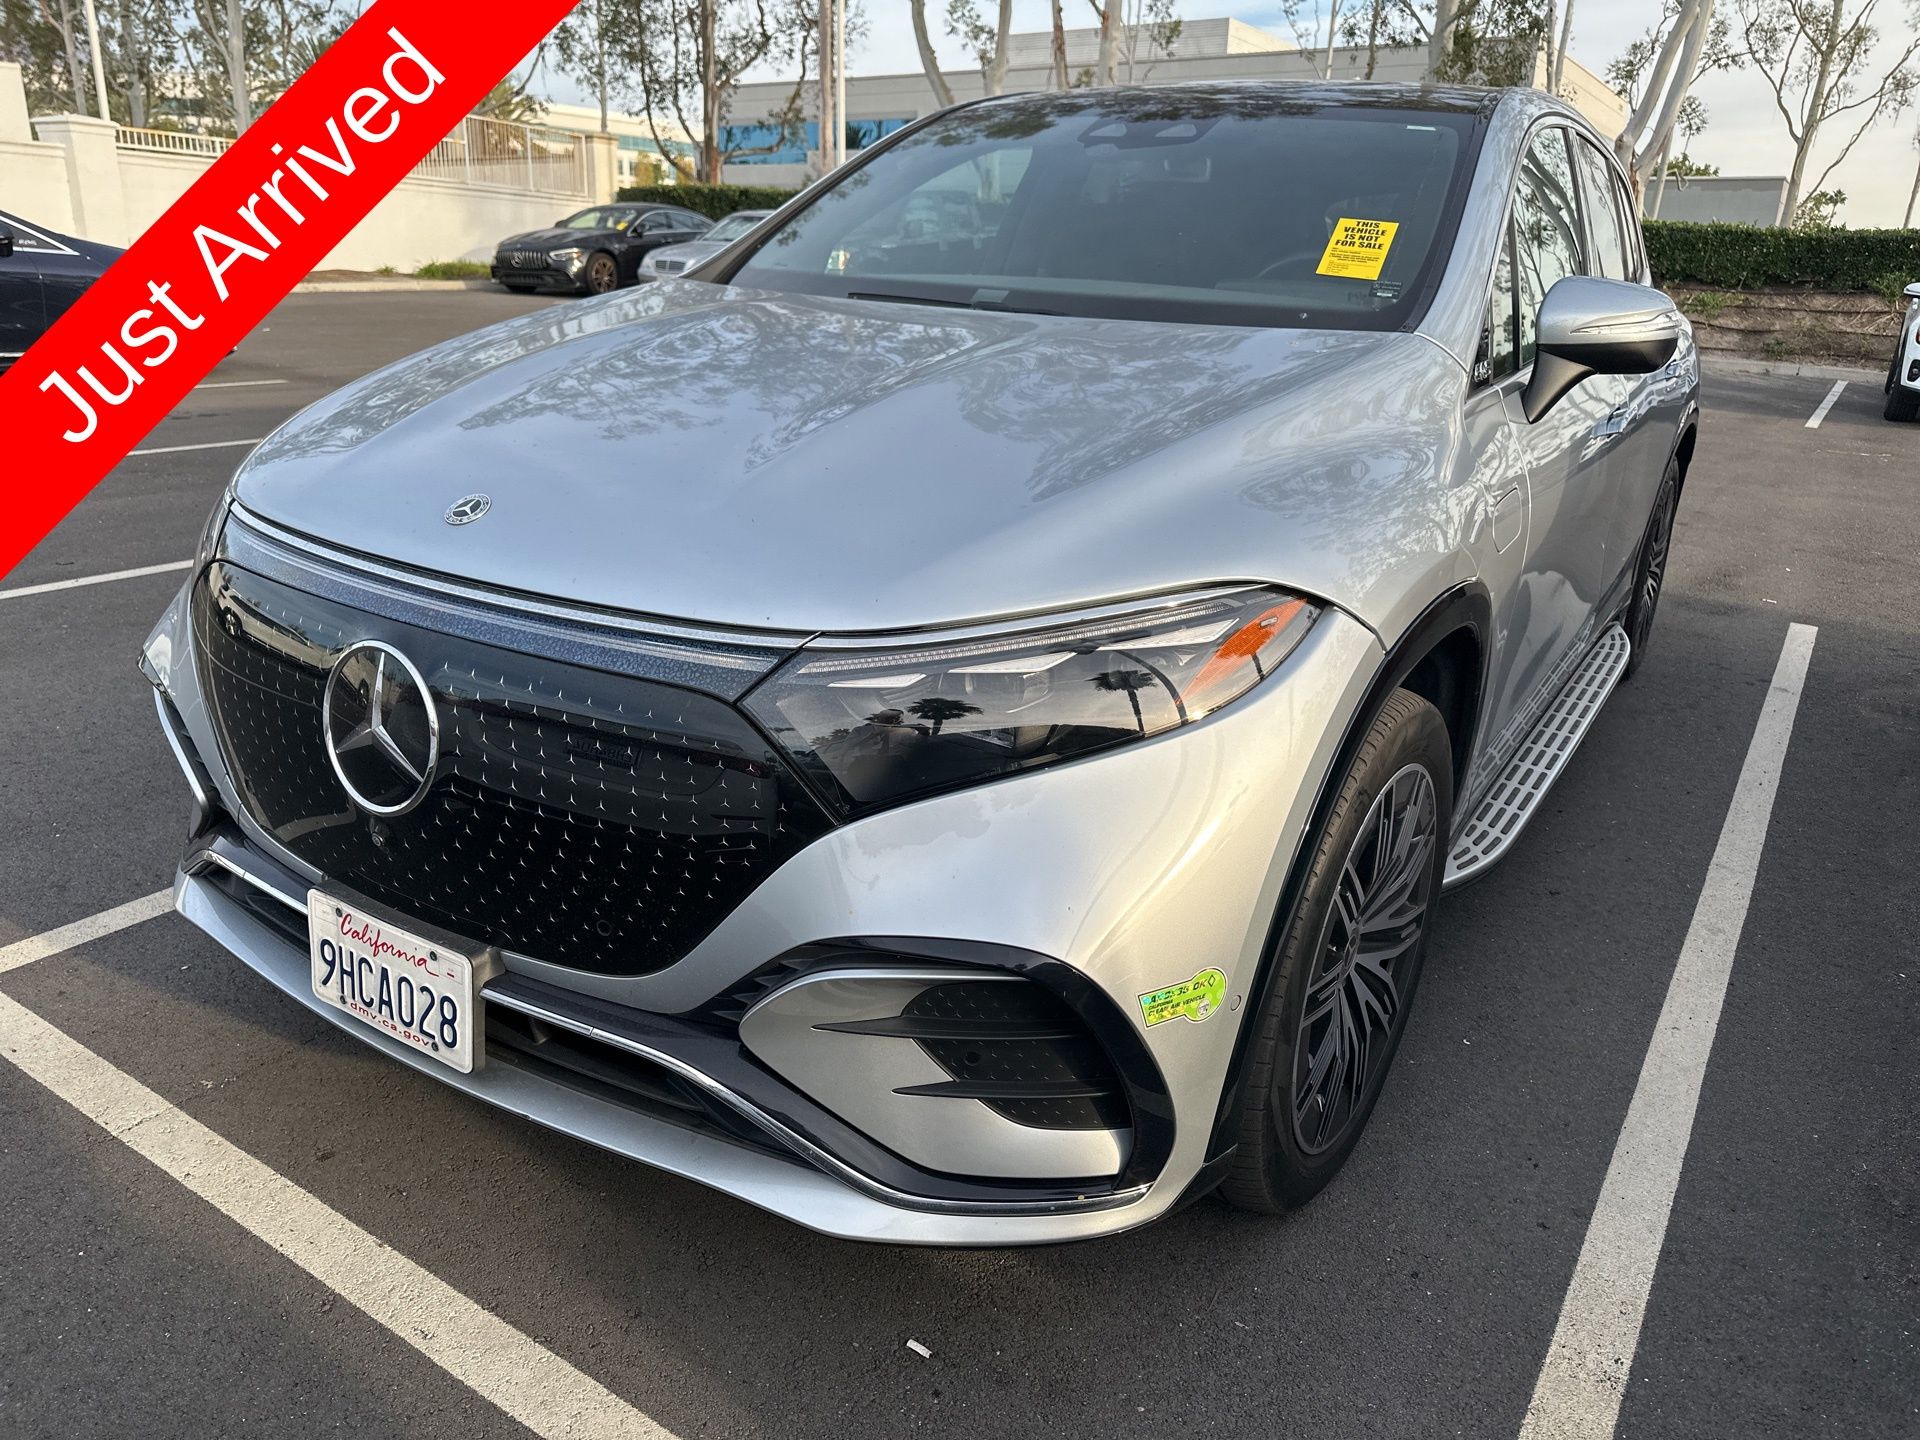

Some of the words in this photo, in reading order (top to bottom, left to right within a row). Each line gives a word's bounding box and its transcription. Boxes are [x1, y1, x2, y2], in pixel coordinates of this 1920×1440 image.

[1344, 227, 1387, 236] VEHICLE
[1335, 239, 1356, 247] FOR
[1358, 241, 1384, 250] SALE
[340, 913, 439, 977] California
[1193, 980, 1207, 990] OK
[319, 938, 458, 1049] 9HCA028
[1183, 994, 1206, 1005] VEHICLE
[350, 1001, 430, 1047] dmv.ca.gov
